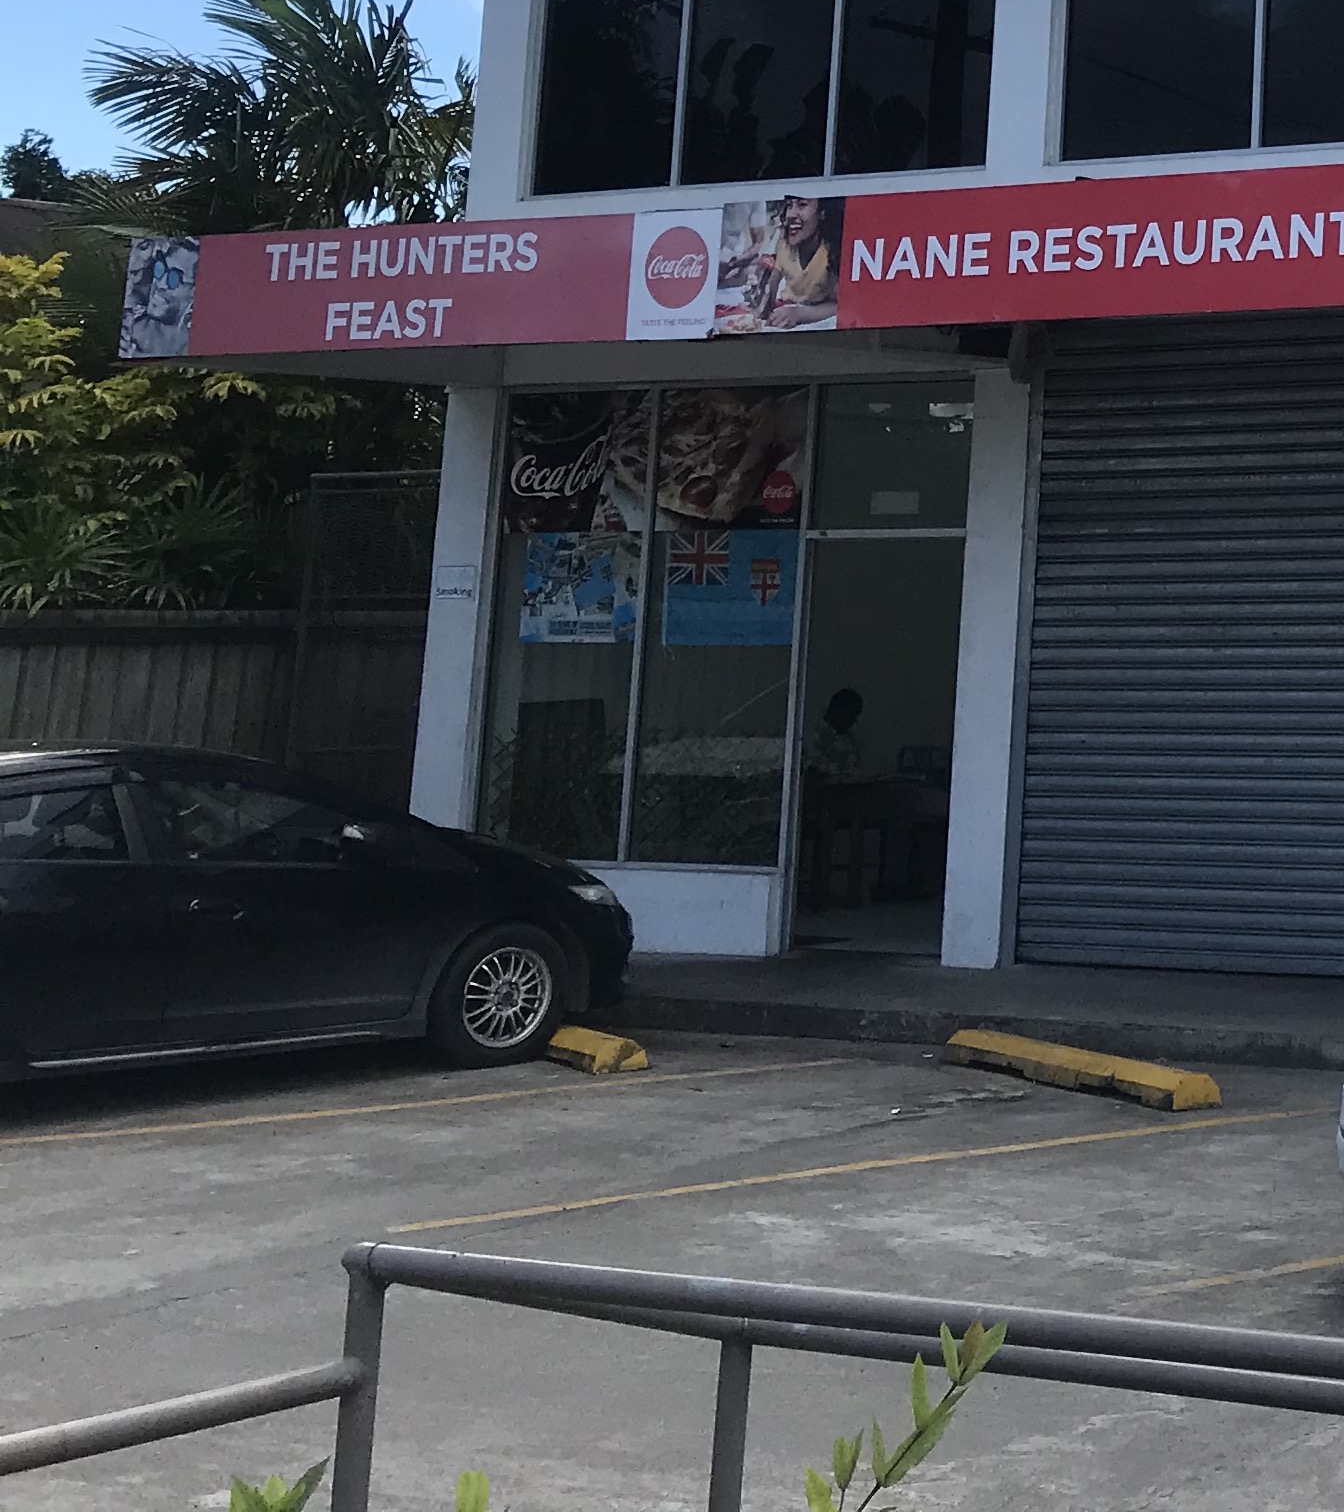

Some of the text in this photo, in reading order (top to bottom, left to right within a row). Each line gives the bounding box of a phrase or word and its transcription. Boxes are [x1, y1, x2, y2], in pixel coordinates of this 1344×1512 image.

[265, 232, 540, 282] THE HUNTERS
[850, 232, 993, 282] NANE
[325, 298, 453, 342] FEAST
